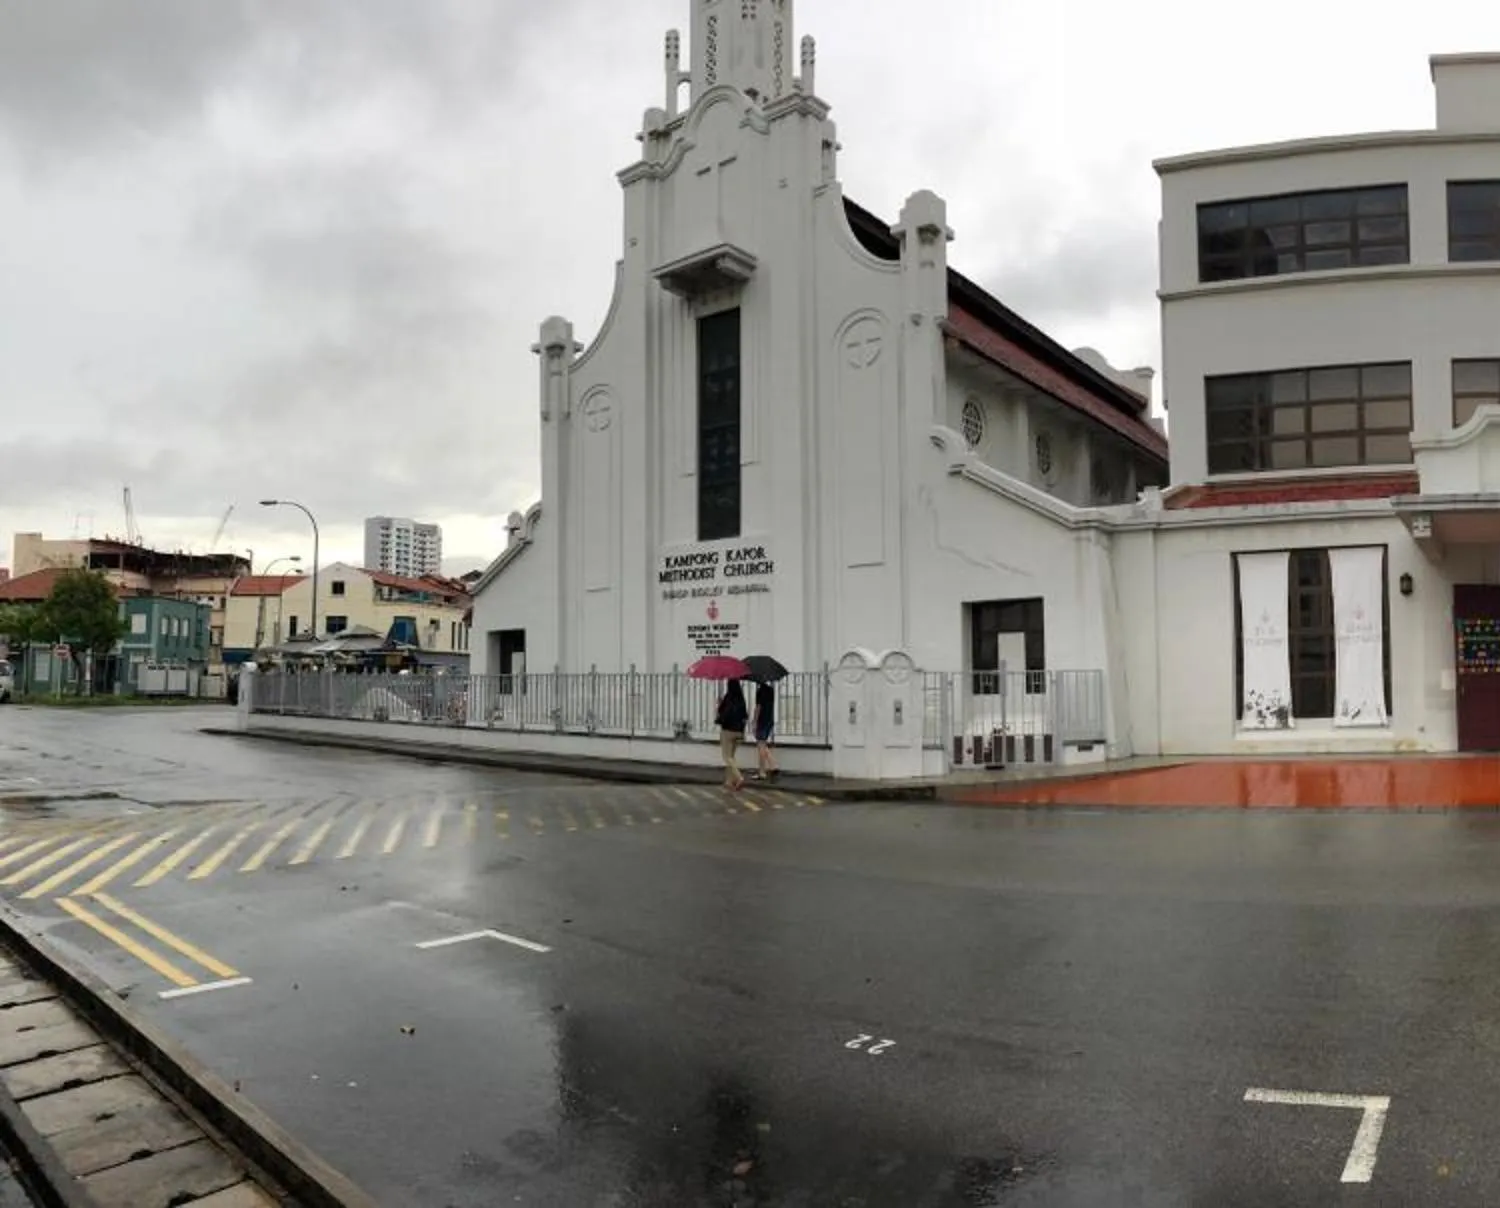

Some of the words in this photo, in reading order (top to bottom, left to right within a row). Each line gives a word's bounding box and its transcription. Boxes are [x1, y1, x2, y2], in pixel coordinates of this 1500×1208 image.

[665, 551, 719, 568] KAMPONG
[725, 546, 766, 562] KAPOR
[659, 567, 716, 582] METHODIST
[723, 562, 774, 577] CHURCH
